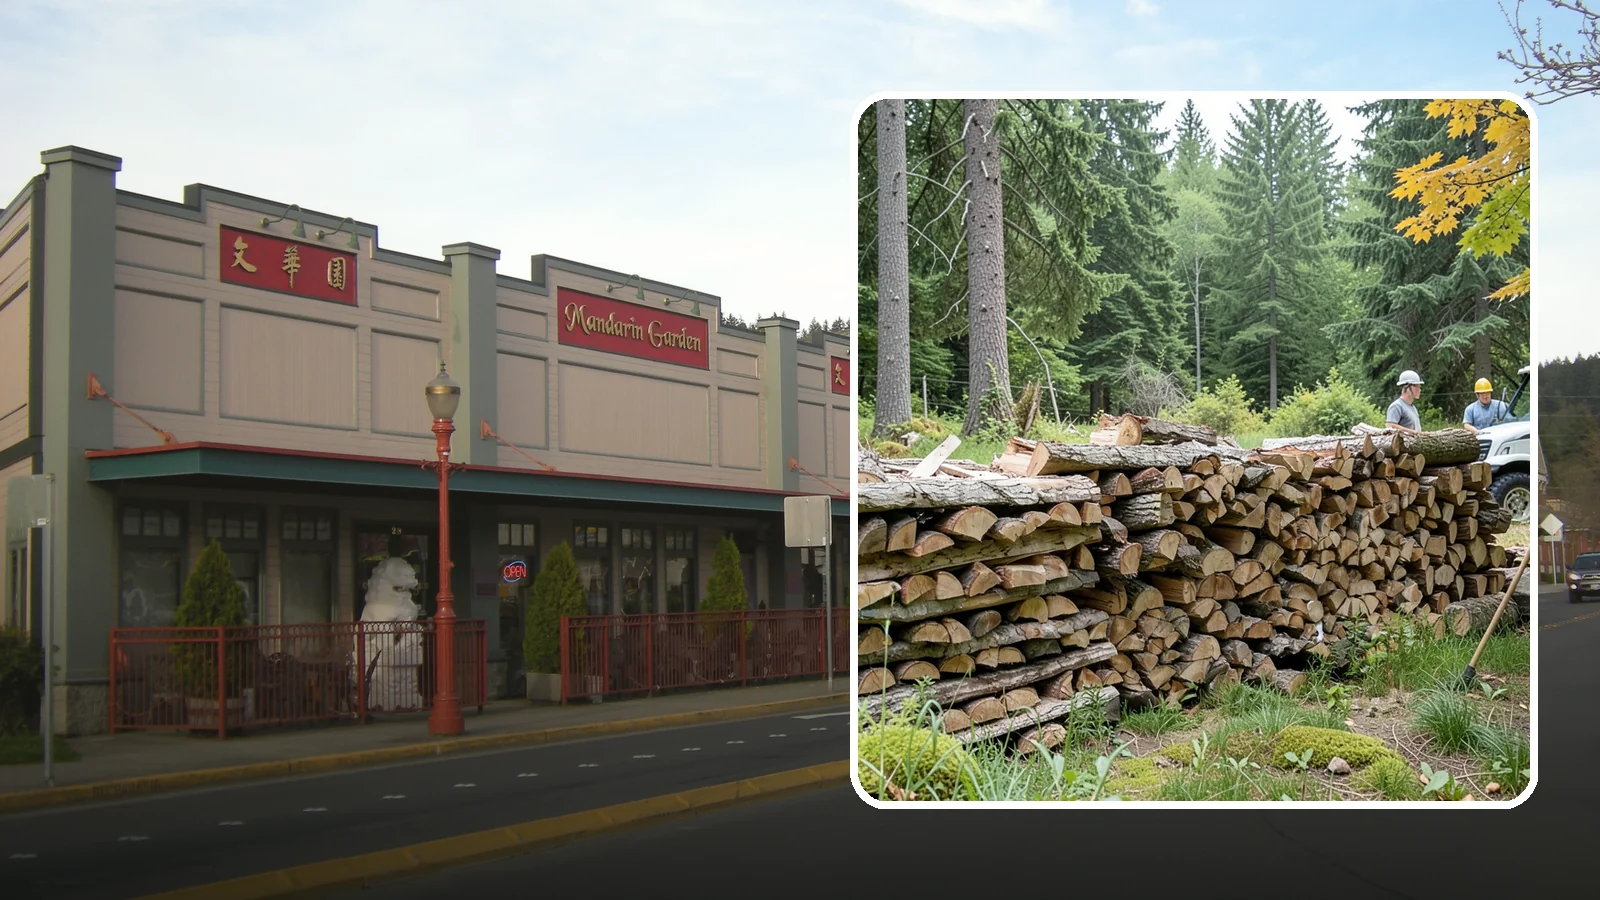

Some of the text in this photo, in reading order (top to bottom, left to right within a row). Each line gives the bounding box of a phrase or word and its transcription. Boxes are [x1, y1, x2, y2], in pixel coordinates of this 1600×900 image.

[565, 302, 701, 351] Mandarin Garden
[503, 565, 527, 578] OPEN
